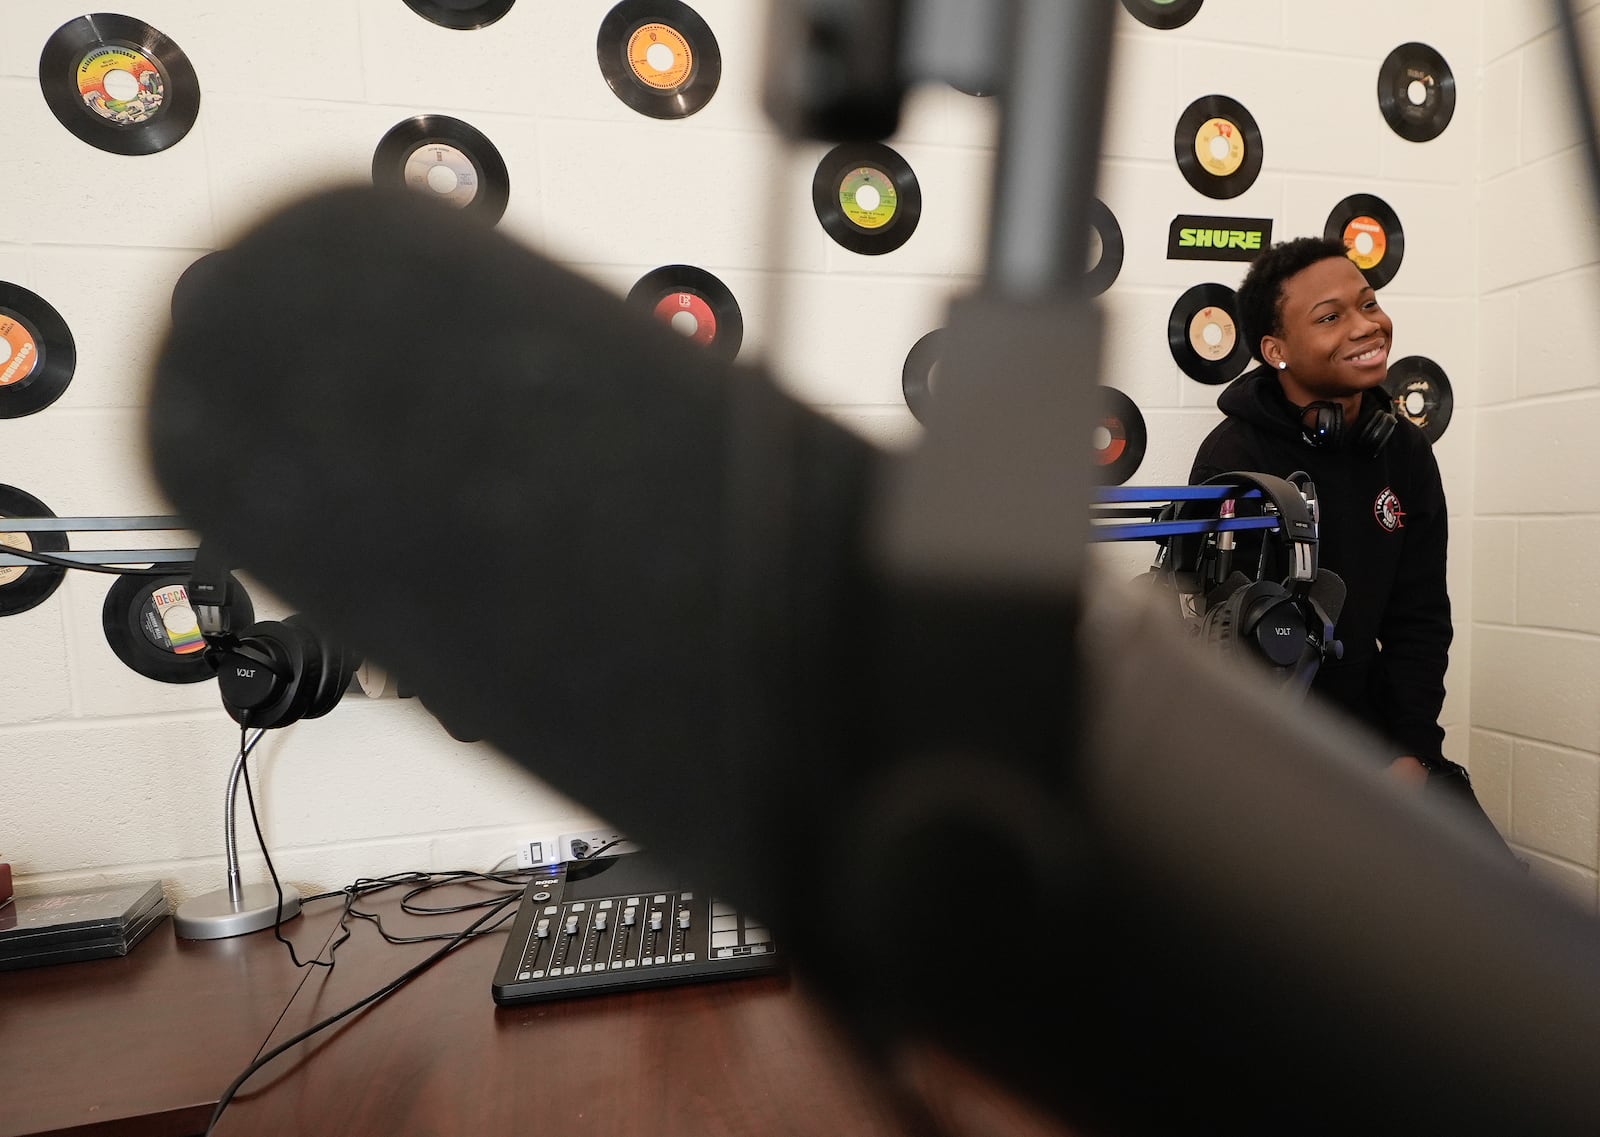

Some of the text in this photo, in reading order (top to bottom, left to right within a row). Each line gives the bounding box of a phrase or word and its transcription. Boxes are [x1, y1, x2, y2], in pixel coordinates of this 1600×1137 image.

[1179, 228, 1262, 250] SHURE
[155, 589, 186, 605] DECCA
[1275, 628, 1291, 636] VOLT
[237, 668, 256, 678] VOLT
